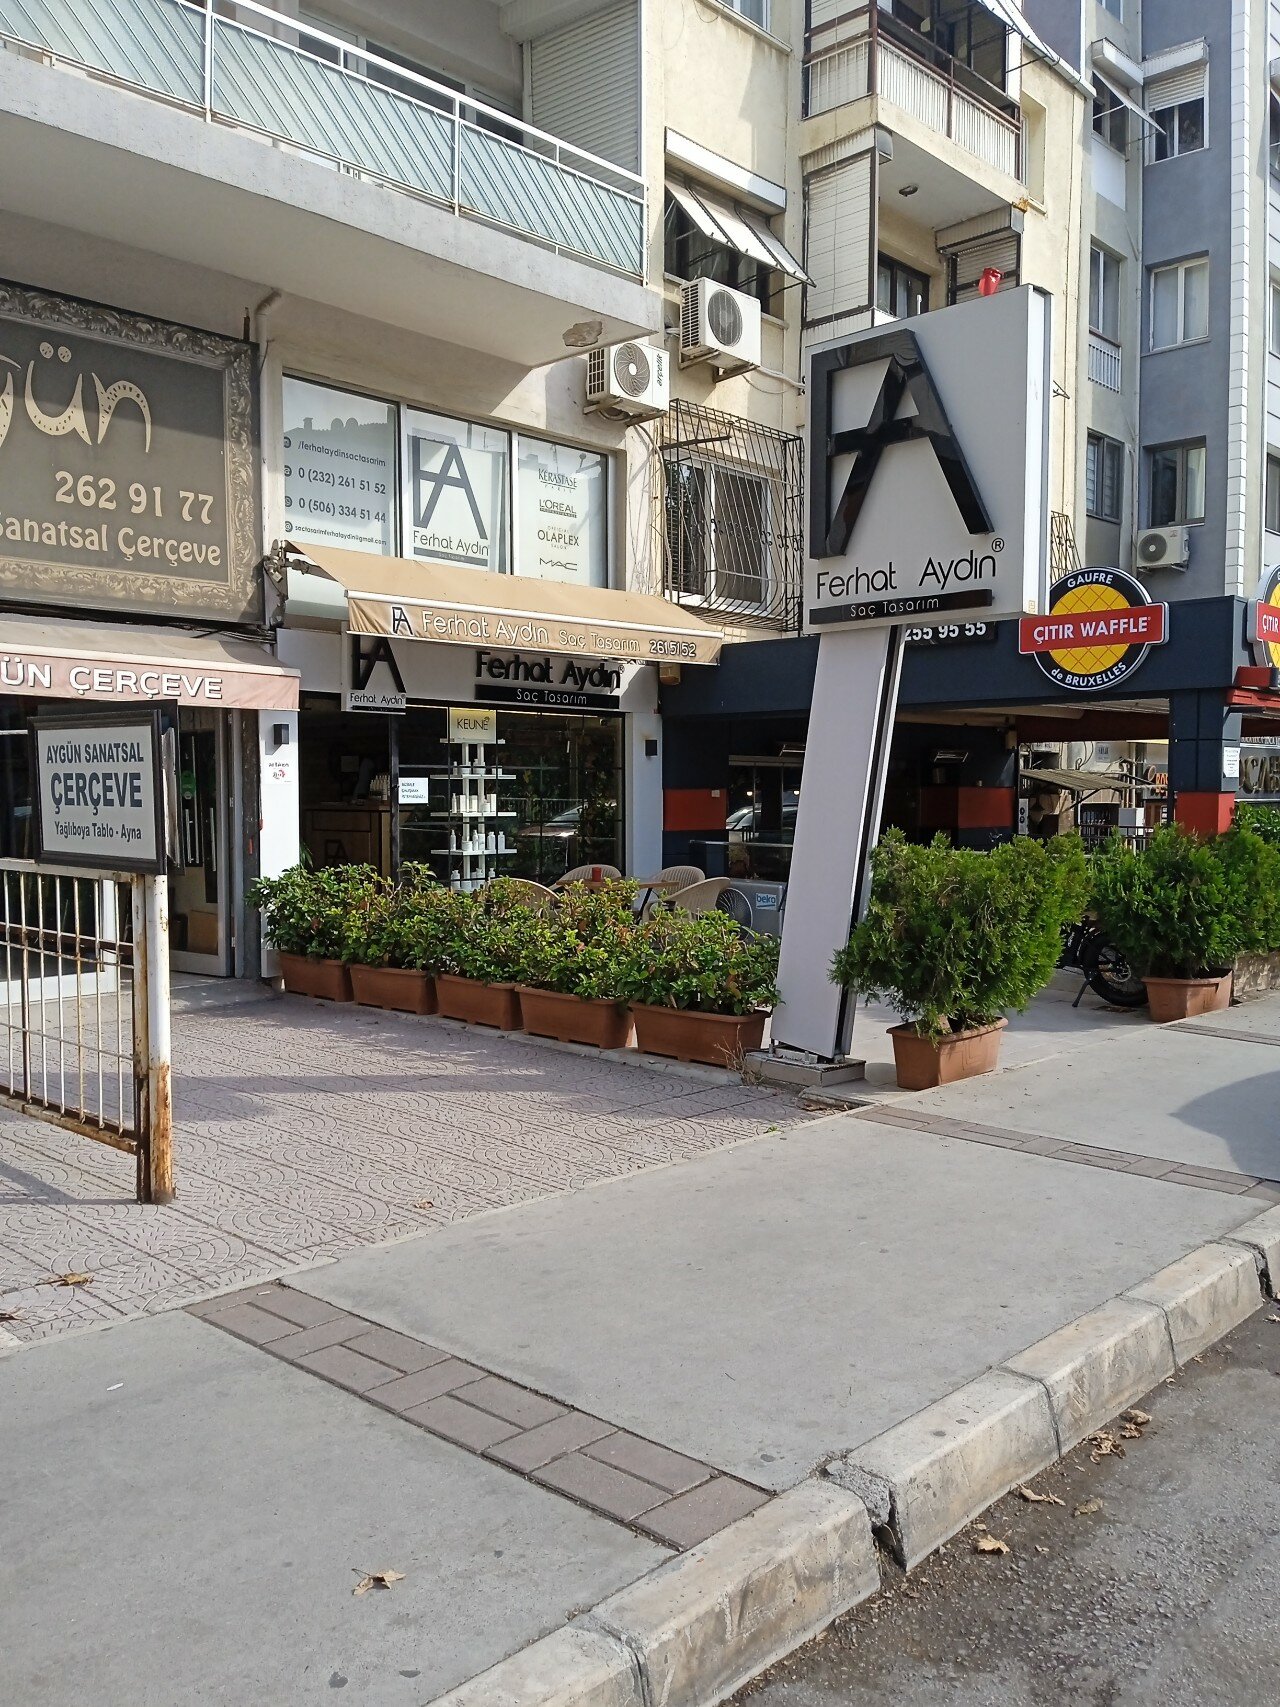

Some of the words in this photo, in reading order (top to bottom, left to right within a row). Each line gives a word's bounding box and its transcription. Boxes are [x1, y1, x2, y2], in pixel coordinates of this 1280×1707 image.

[298, 467, 305, 478] 0
[308, 468, 335, 487] (232)
[338, 475, 356, 489] 261
[359, 481, 371, 491] 51
[374, 483, 386, 495] 52
[55, 470, 117, 511] 262
[128, 482, 163, 518] 91
[179, 490, 214, 525] 77
[298, 498, 306, 509] 0
[308, 498, 336, 517] (506)
[338, 505, 356, 518] 334
[359, 509, 371, 521] 51
[374, 512, 386, 523] 44
[118, 526, 221, 567] Çerçeve
[413, 530, 453, 550] Ferhat
[456, 538, 489, 557] Aydın
[538, 529, 579, 546] OLAPLEX
[540, 557, 577, 571] MAC
[816, 561, 897, 600] Ferhat
[1066, 572, 1114, 588] GAUFRE
[850, 602, 876, 617] Saç
[882, 597, 939, 615] Tasarım
[422, 609, 489, 638] Ferhat
[495, 622, 549, 647] Aydın
[559, 629, 586, 649] Saç
[591, 632, 640, 652] Tasarım
[649, 640, 697, 657] 2615152
[938, 625, 959, 639] 95
[965, 622, 987, 636] 55
[1033, 624, 1074, 644] ÇITIR
[1080, 616, 1148, 637] WAFFLE
[475, 650, 553, 684] Ferhat
[1051, 667, 1063, 681] de
[1065, 661, 1127, 686] BRUXELLES
[69, 666, 223, 699] ÇERÇEVE
[350, 693, 376, 704] Ferhat
[517, 688, 539, 703] Saç
[544, 690, 587, 705] Tasarım
[456, 718, 488, 730] KEUNE
[46, 741, 82, 764] AYGÜN
[84, 742, 144, 763] SANATSAL
[50, 771, 143, 815] ÇERÇEVE
[54, 821, 90, 840] Yağlıboya
[92, 822, 114, 838] Tablo
[120, 823, 142, 842] Ayna
[756, 894, 776, 904] beko
